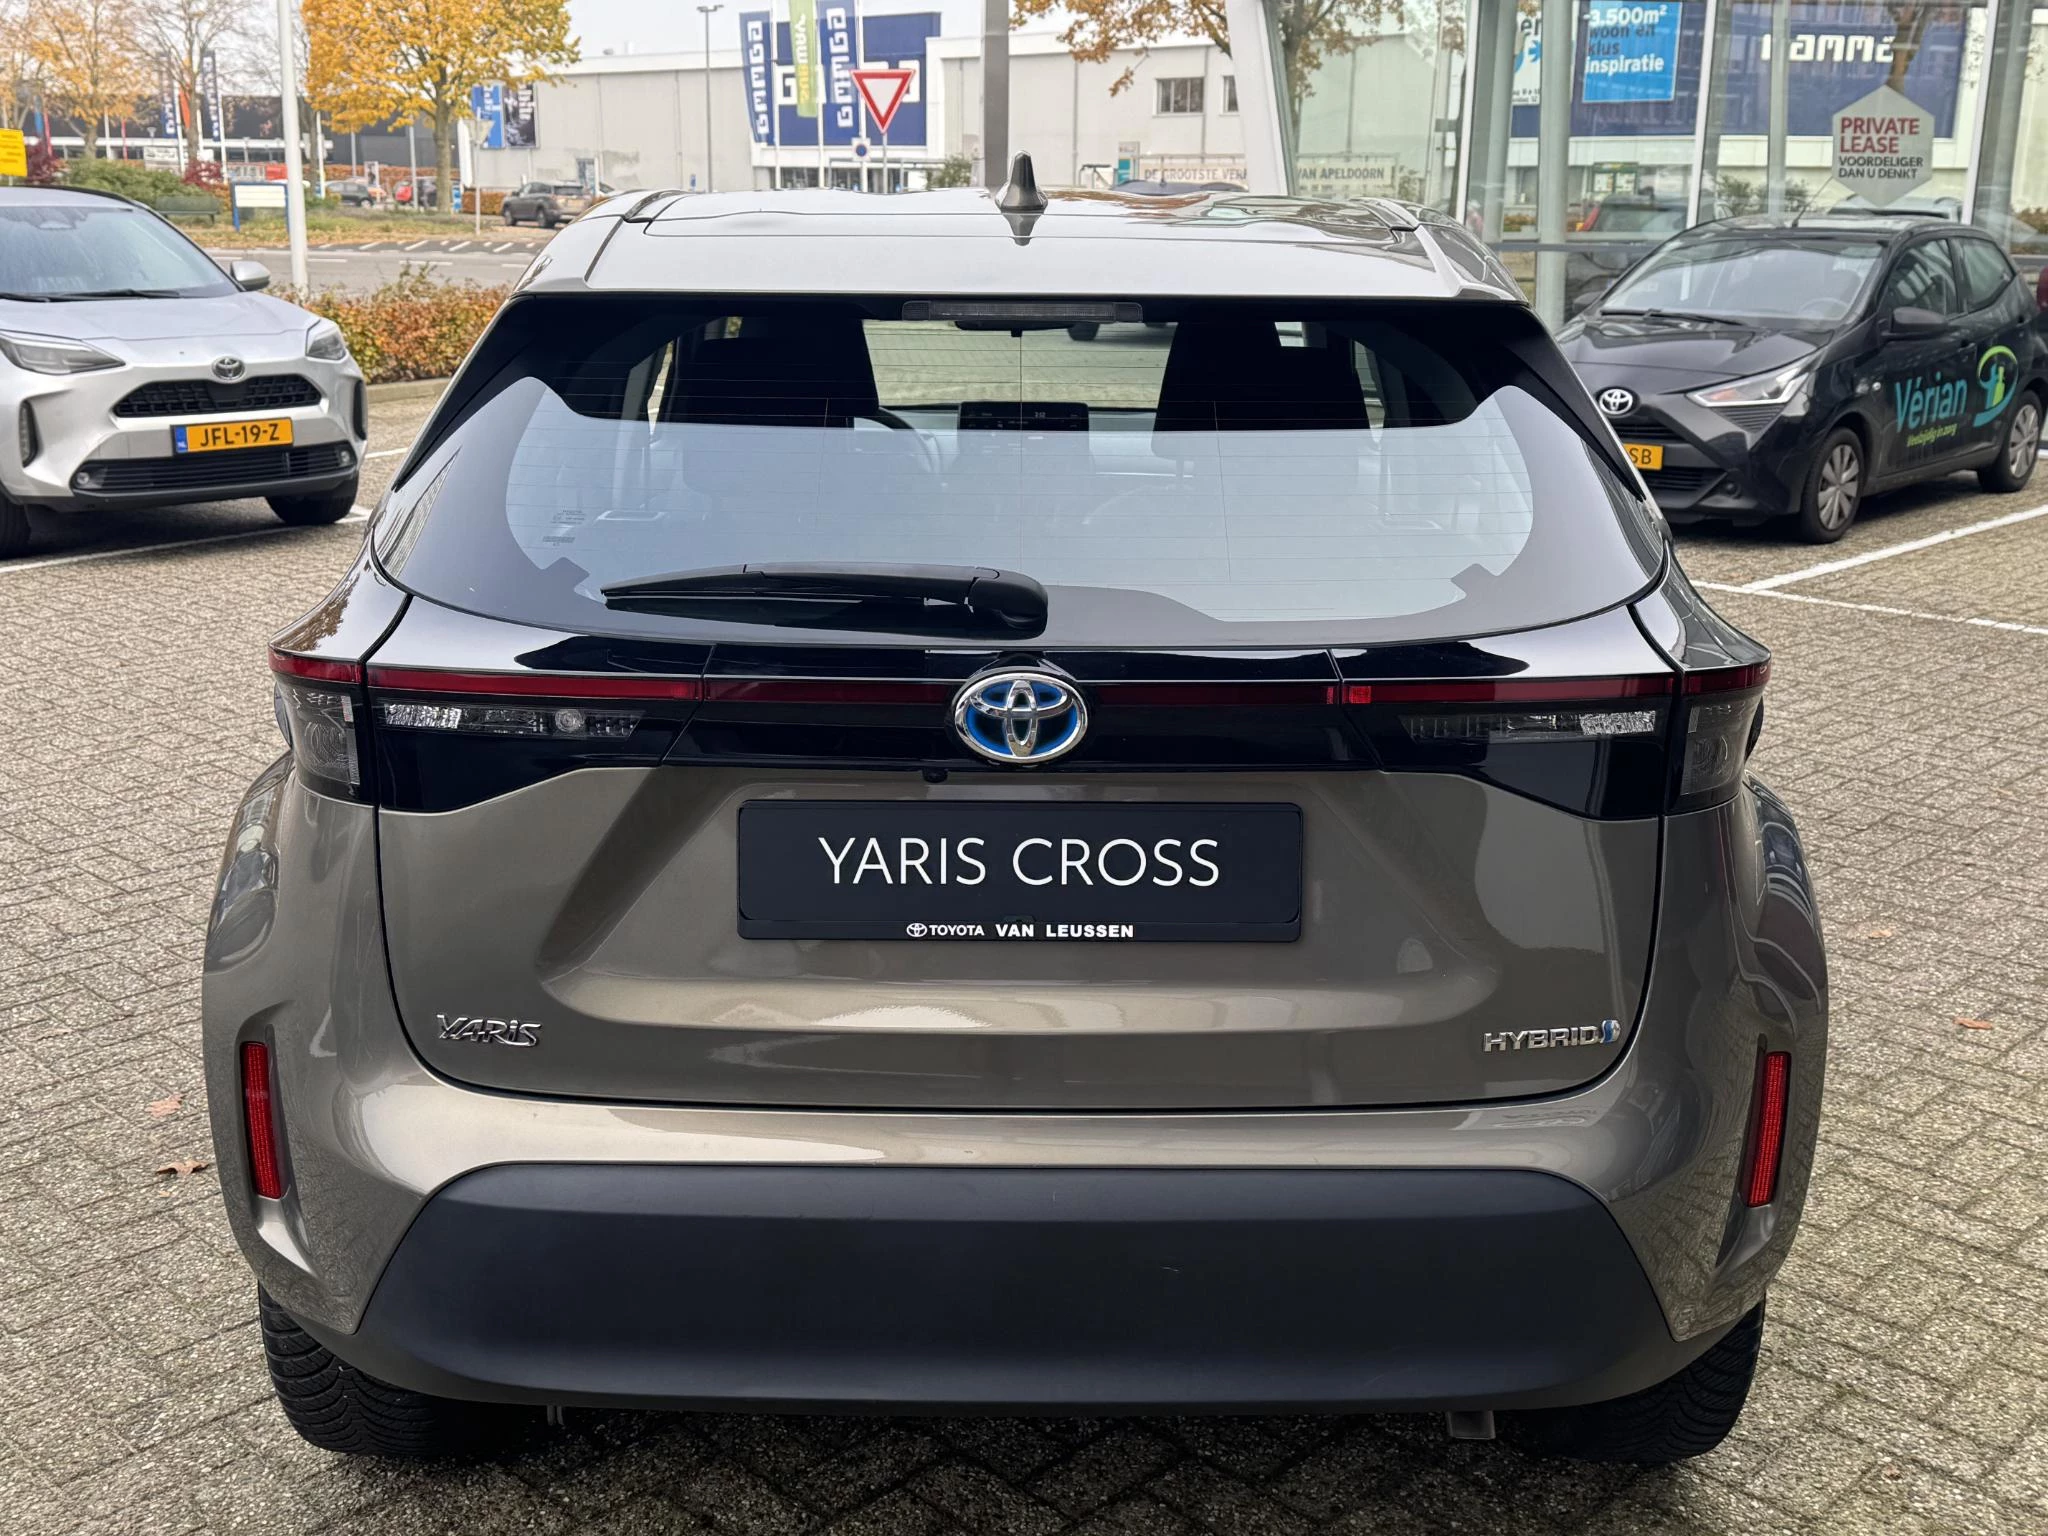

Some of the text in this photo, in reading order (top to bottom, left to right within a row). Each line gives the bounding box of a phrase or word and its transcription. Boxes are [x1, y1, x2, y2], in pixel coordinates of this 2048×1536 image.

[1584, 53, 1665, 77] inspiratie
[1840, 117, 1920, 135] PRIVATE
[1839, 136, 1900, 154] LEASE
[1838, 156, 1923, 167] VOORDELIGER
[1320, 168, 1385, 180] APELDOORN
[1838, 168, 1918, 179] DAN U DENKT
[1894, 370, 1968, 433] Vérian
[200, 424, 280, 446] JFL-19-Z
[817, 836, 1220, 887] YARIS CROSS
[929, 923, 1134, 938] TOYOTA VAN LEUSSEN
[1484, 1025, 1599, 1052] HYBRID
